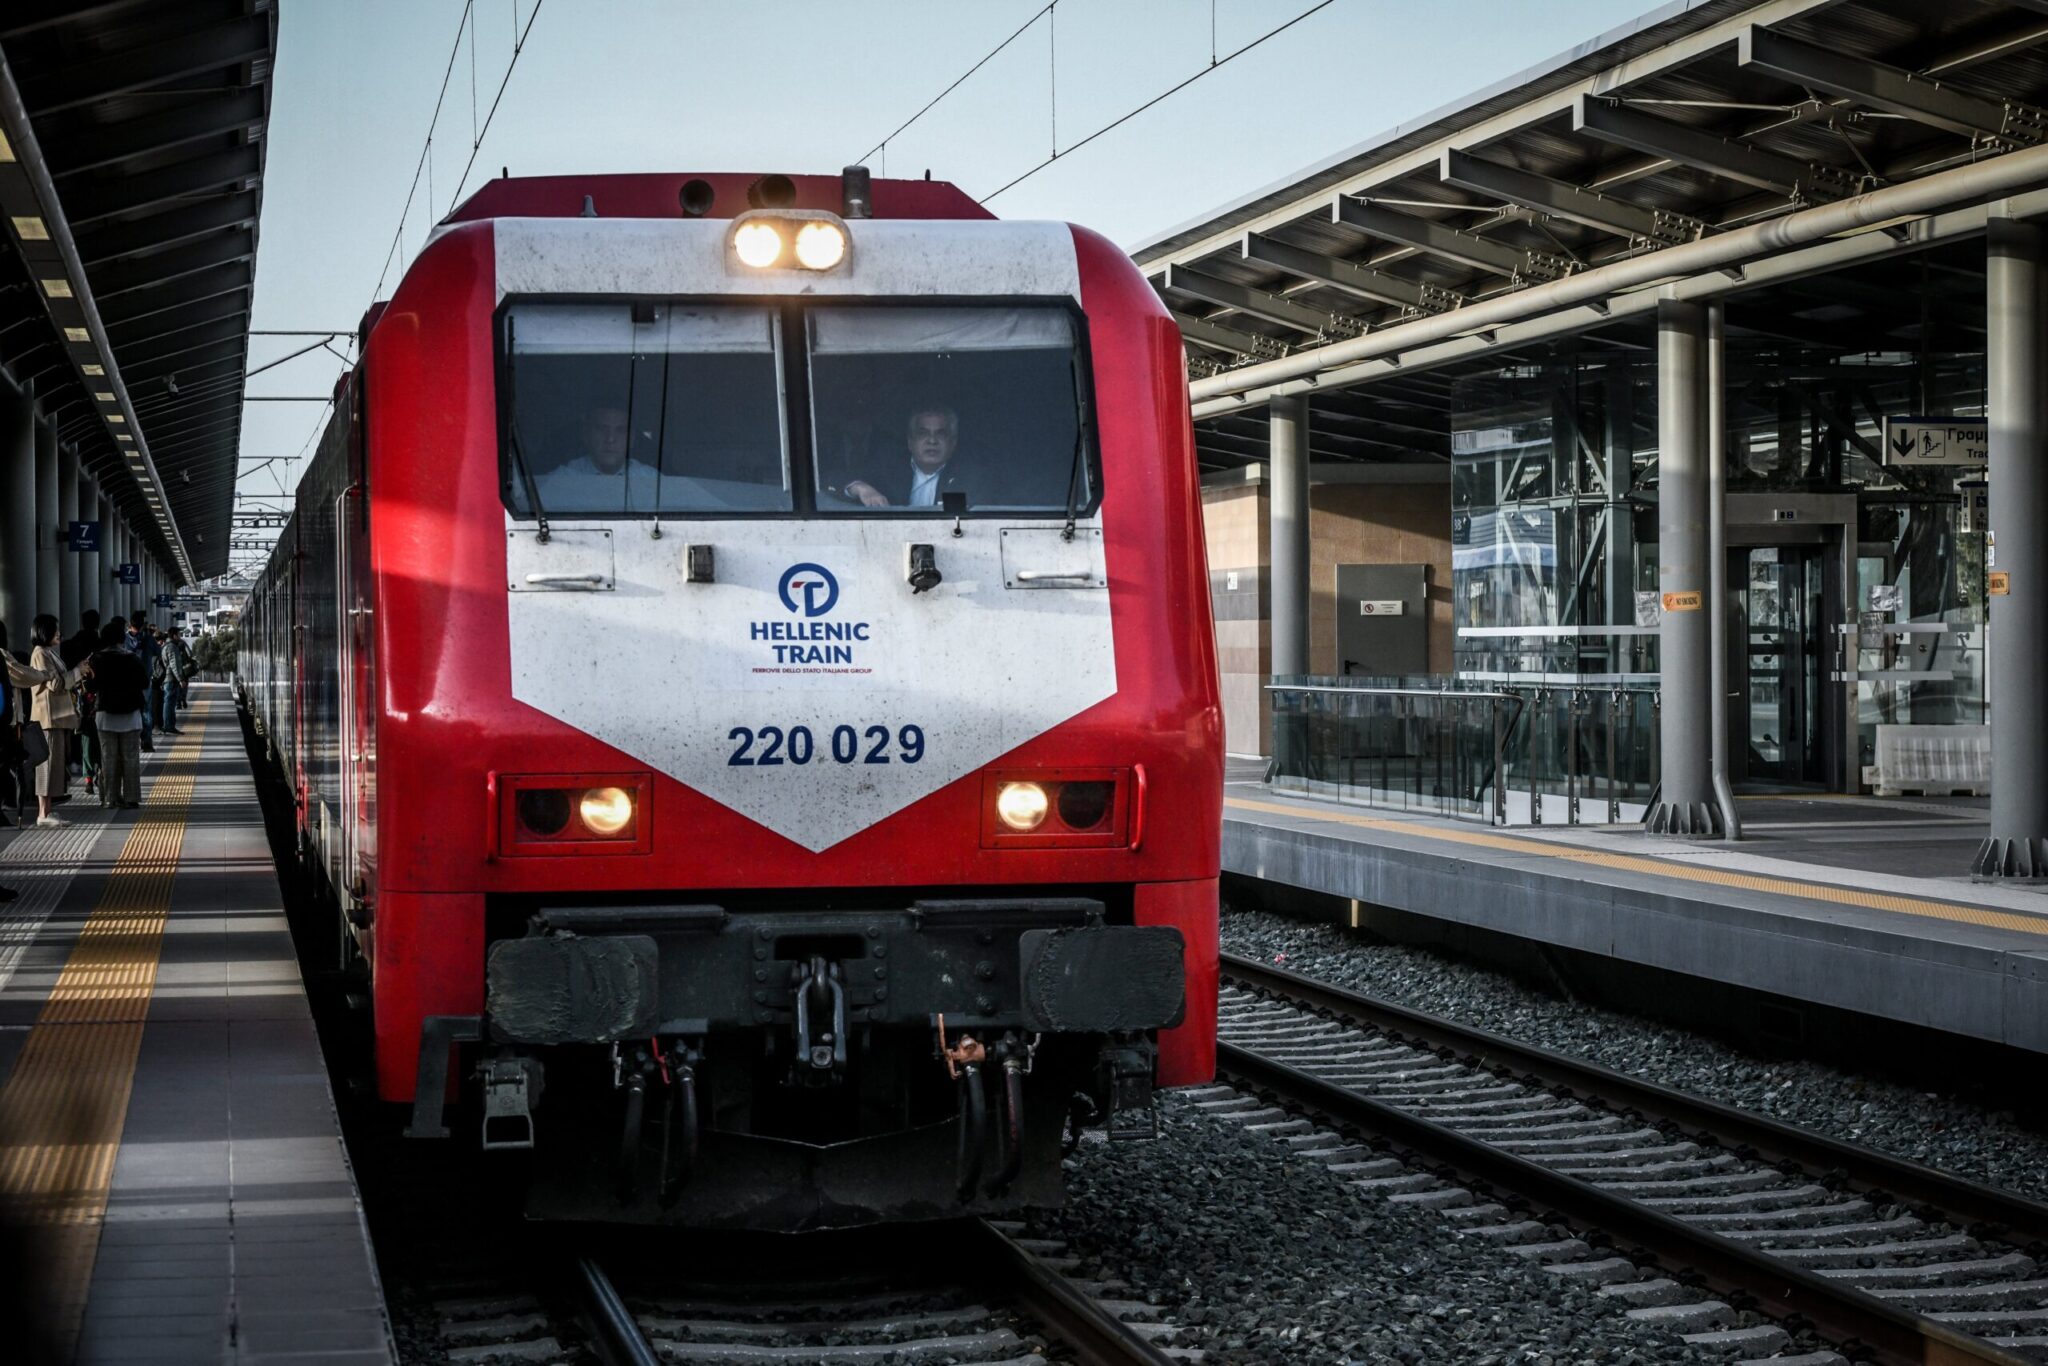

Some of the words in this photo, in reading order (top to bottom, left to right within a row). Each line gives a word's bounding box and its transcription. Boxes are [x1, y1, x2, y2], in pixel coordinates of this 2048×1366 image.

[80, 525, 89, 538] 7
[126, 566, 133, 575] 7
[750, 622, 870, 641] HELLENIC
[772, 645, 852, 664] TRAIN
[727, 725, 814, 766] 220
[831, 724, 925, 764] 029
